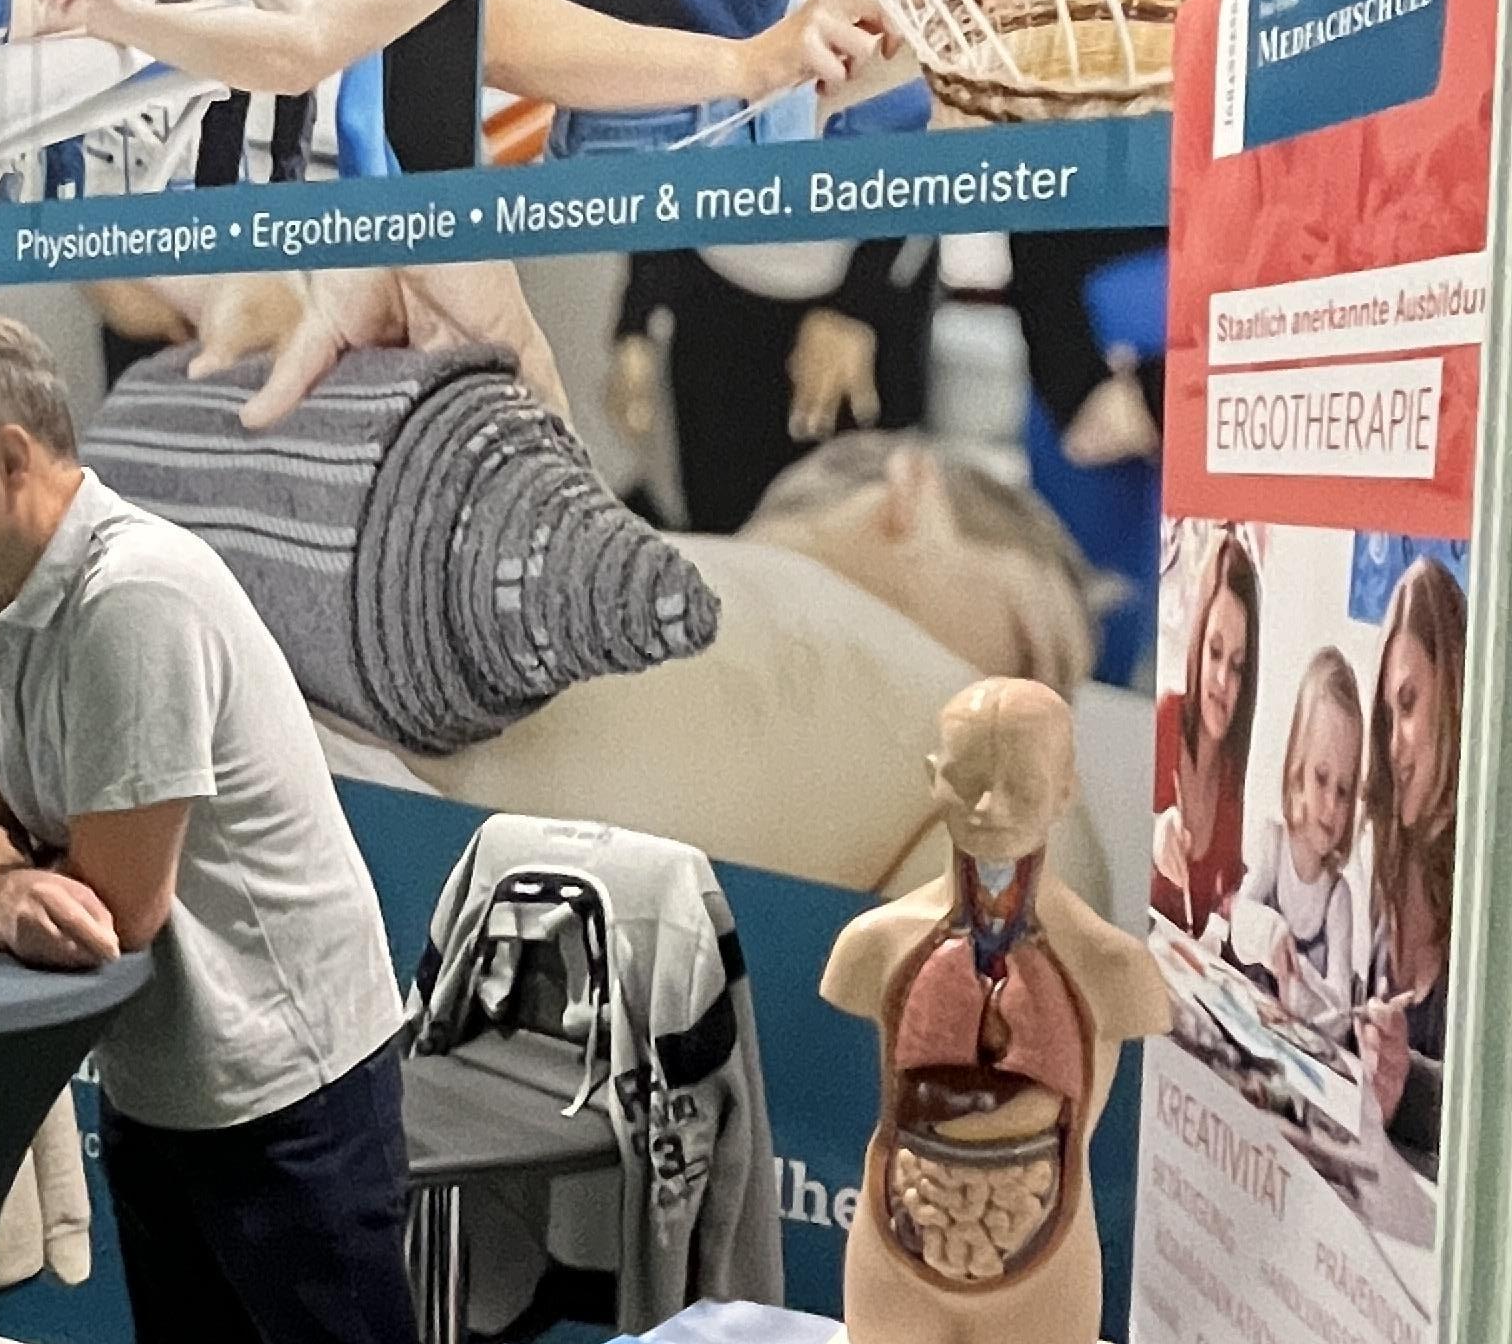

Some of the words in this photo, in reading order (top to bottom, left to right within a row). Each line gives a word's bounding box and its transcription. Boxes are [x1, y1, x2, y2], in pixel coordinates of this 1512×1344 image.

[16, 216, 216, 269] Physiotherapie
[252, 202, 456, 254] Ergotherapie
[495, 191, 645, 236] Masseur
[655, 183, 681, 222] &
[695, 175, 793, 221] med.
[809, 161, 1079, 215] Bademeister
[1217, 305, 1286, 342] Staatlich
[1291, 296, 1390, 335] anerkannte
[1216, 387, 1433, 453] ERGOTHERAPIE
[1156, 1073, 1292, 1223] KREATIVITÄT
